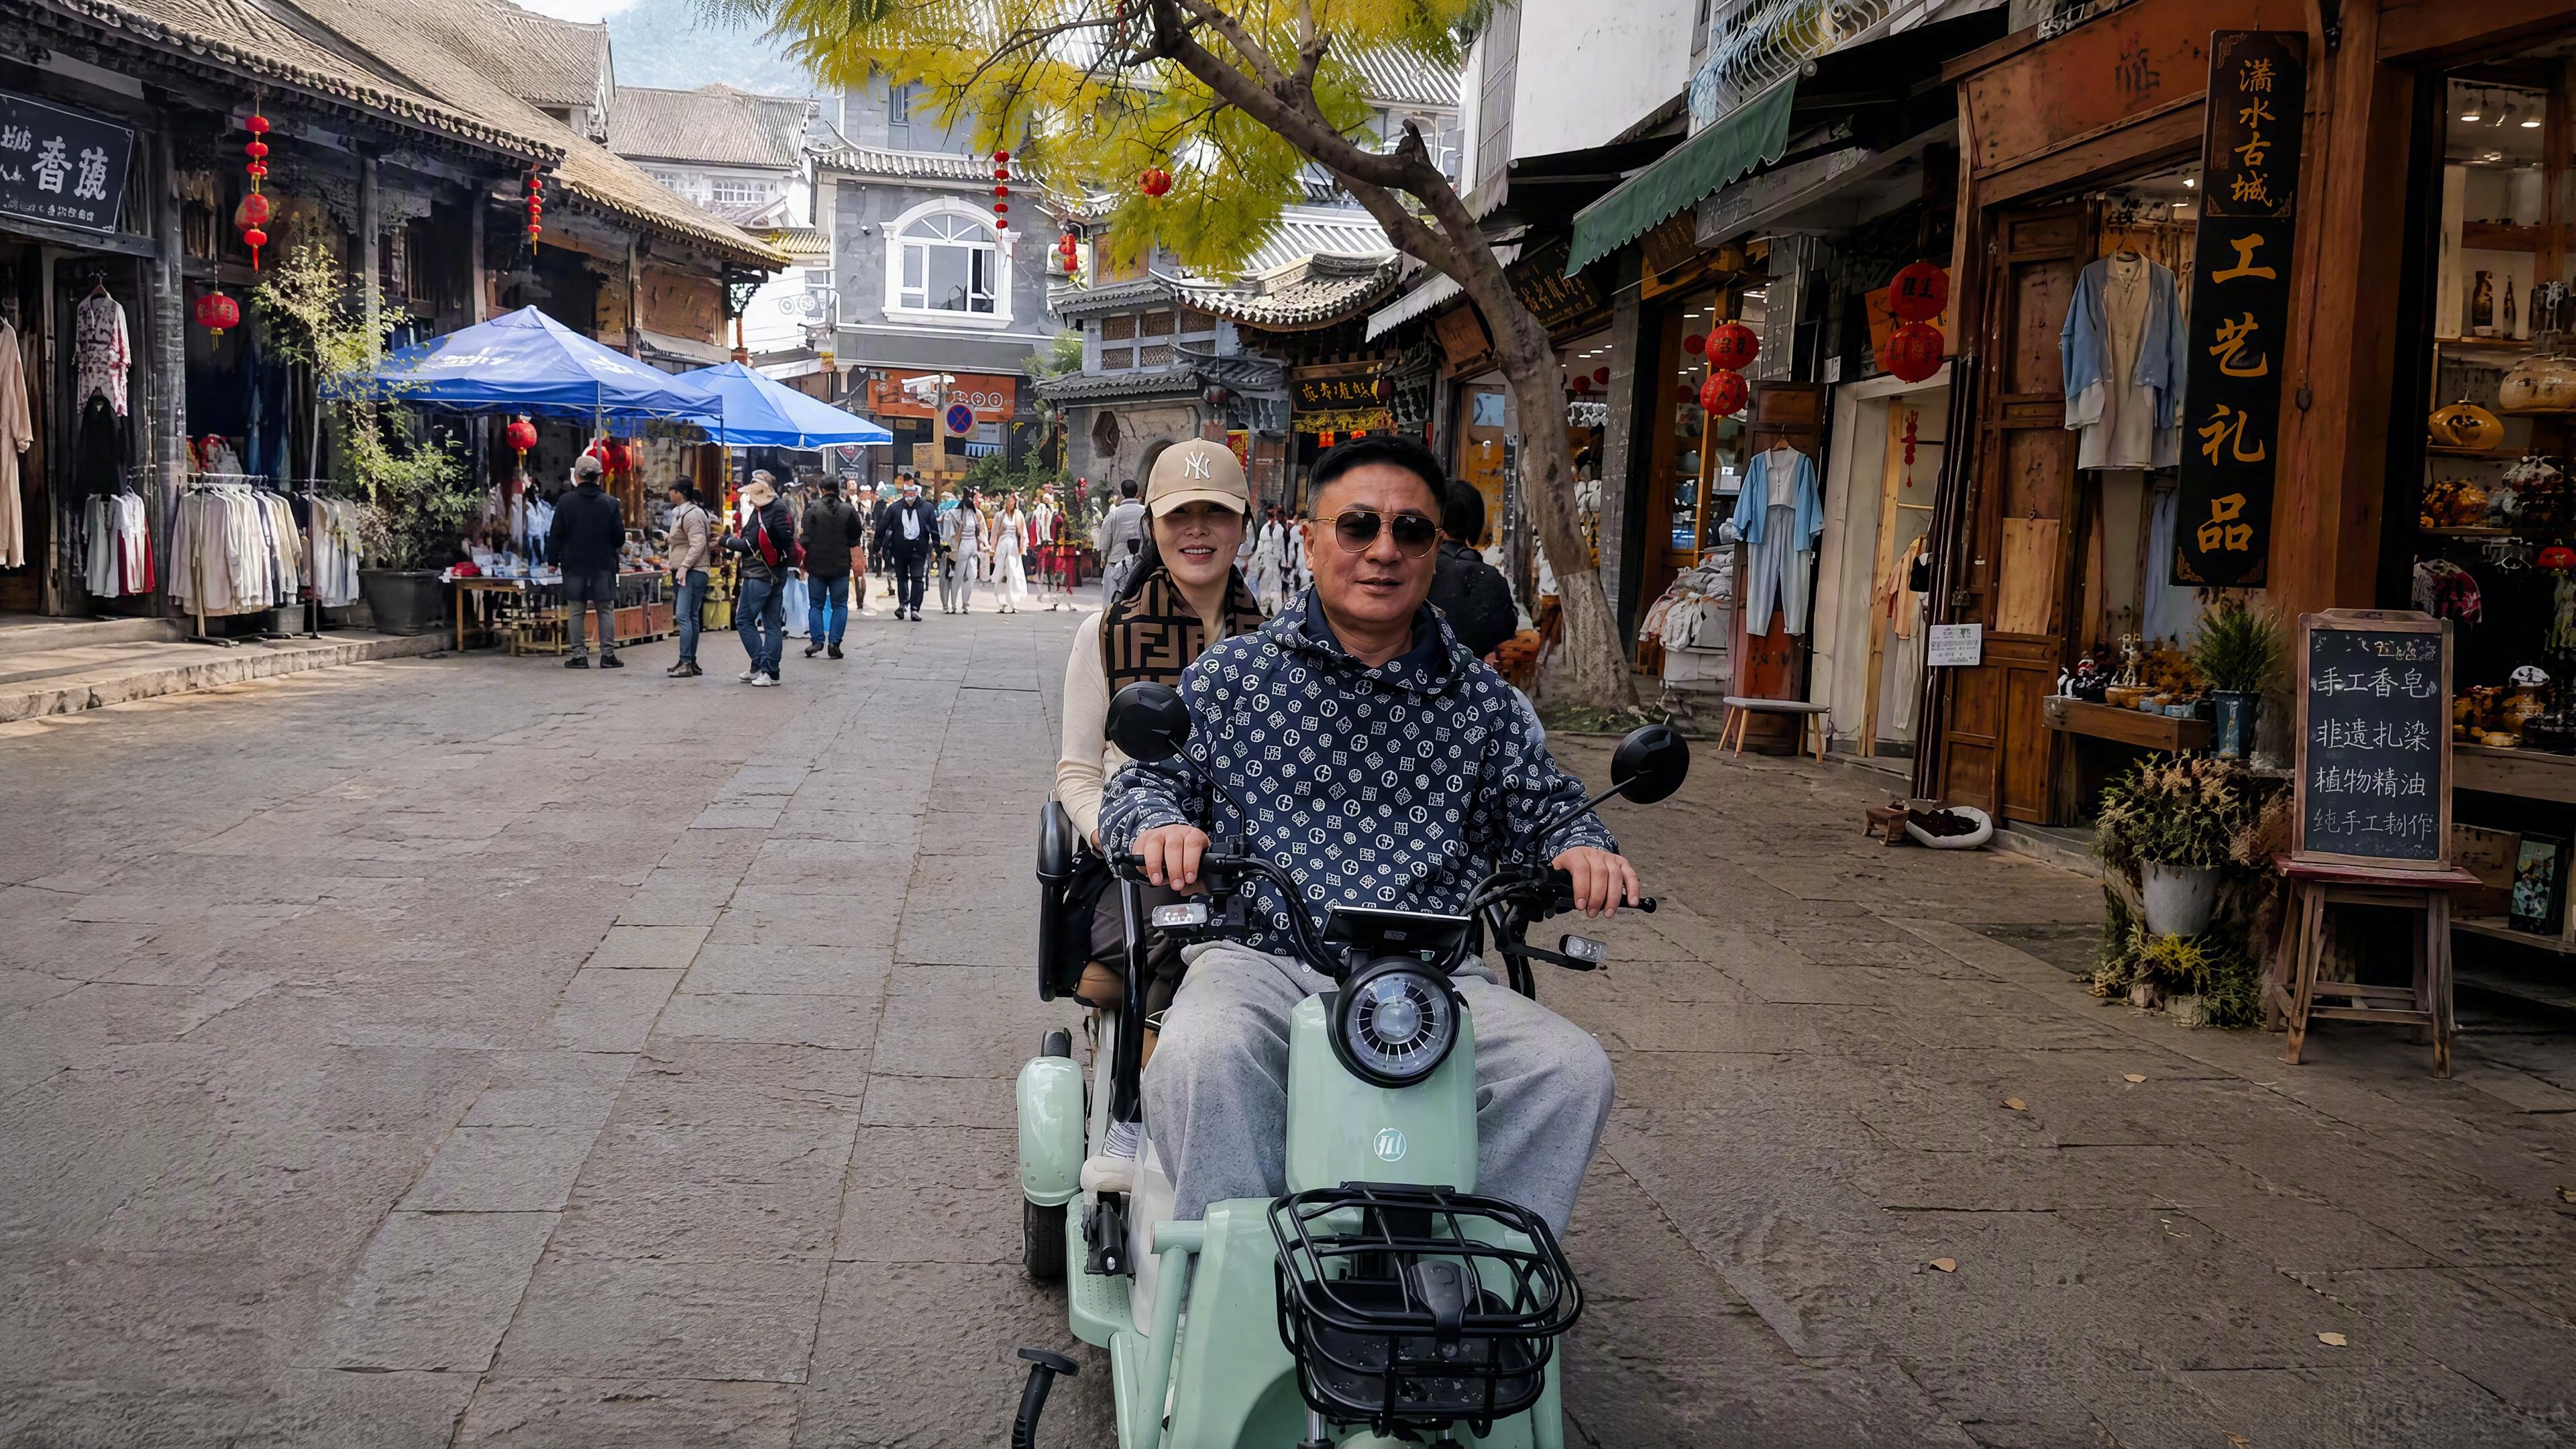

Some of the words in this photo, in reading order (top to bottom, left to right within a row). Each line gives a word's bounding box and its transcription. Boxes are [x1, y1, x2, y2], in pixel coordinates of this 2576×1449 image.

[2197, 233, 2277, 553] 工艺礼品
[1184, 450, 1211, 480] NY
[2318, 666, 2430, 698] 手工香皂
[2316, 718, 2430, 751] 非遗扎染
[2314, 765, 2426, 798] 植物精油
